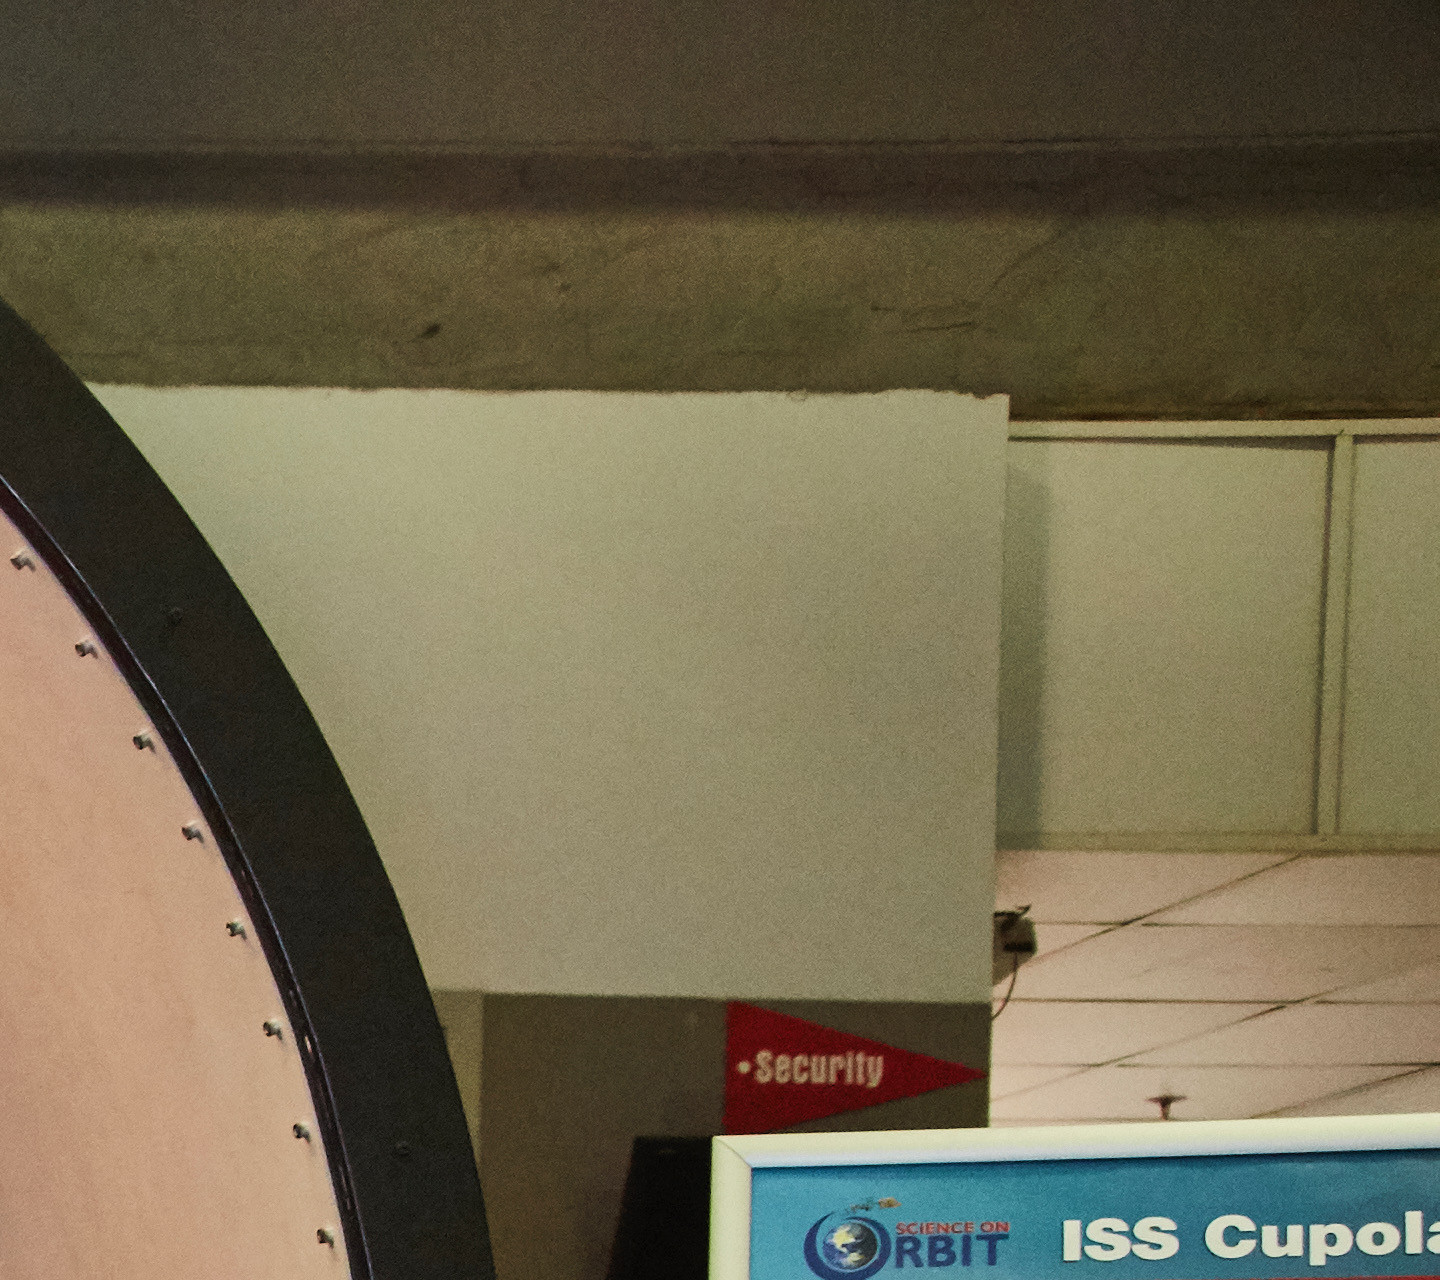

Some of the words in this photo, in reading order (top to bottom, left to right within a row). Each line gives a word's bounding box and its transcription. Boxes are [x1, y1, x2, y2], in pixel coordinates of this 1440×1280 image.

[754, 1049, 885, 1089] Security
[896, 1221, 975, 1235] SCIENCE
[980, 1221, 1011, 1233] ON
[1063, 1216, 1180, 1262] ISS
